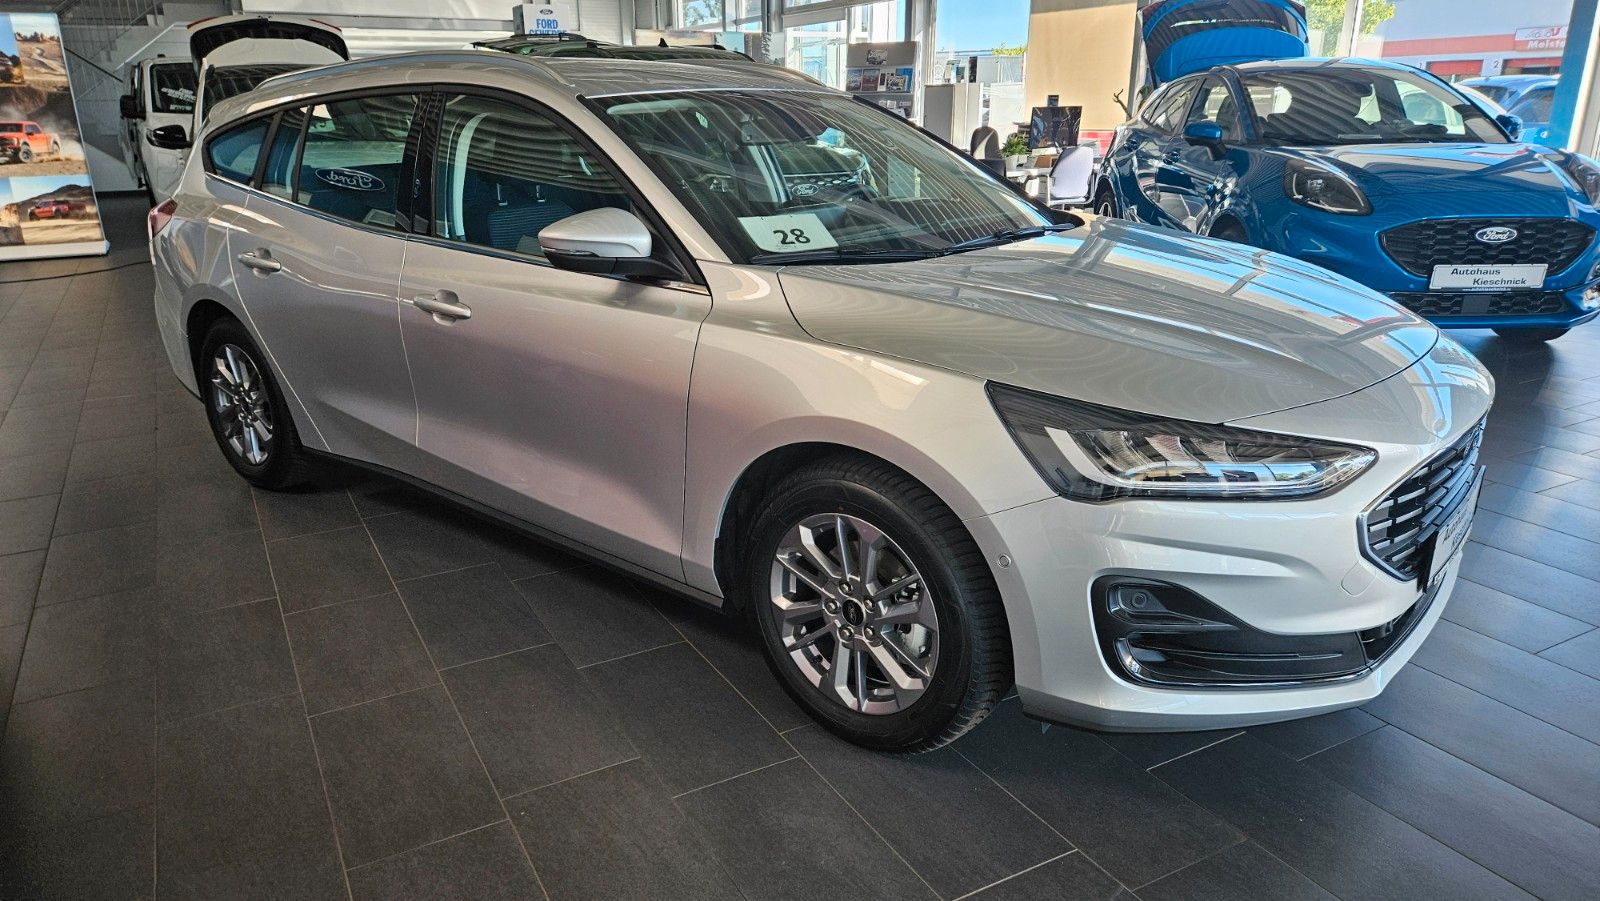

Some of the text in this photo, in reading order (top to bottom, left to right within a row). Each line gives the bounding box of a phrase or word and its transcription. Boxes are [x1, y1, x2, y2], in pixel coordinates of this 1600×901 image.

[536, 18, 558, 29] FORD
[1493, 60, 1499, 69] 2
[773, 228, 811, 245] 28
[1451, 267, 1501, 276] Autohaus
[1473, 278, 1527, 286] Kieschnick
